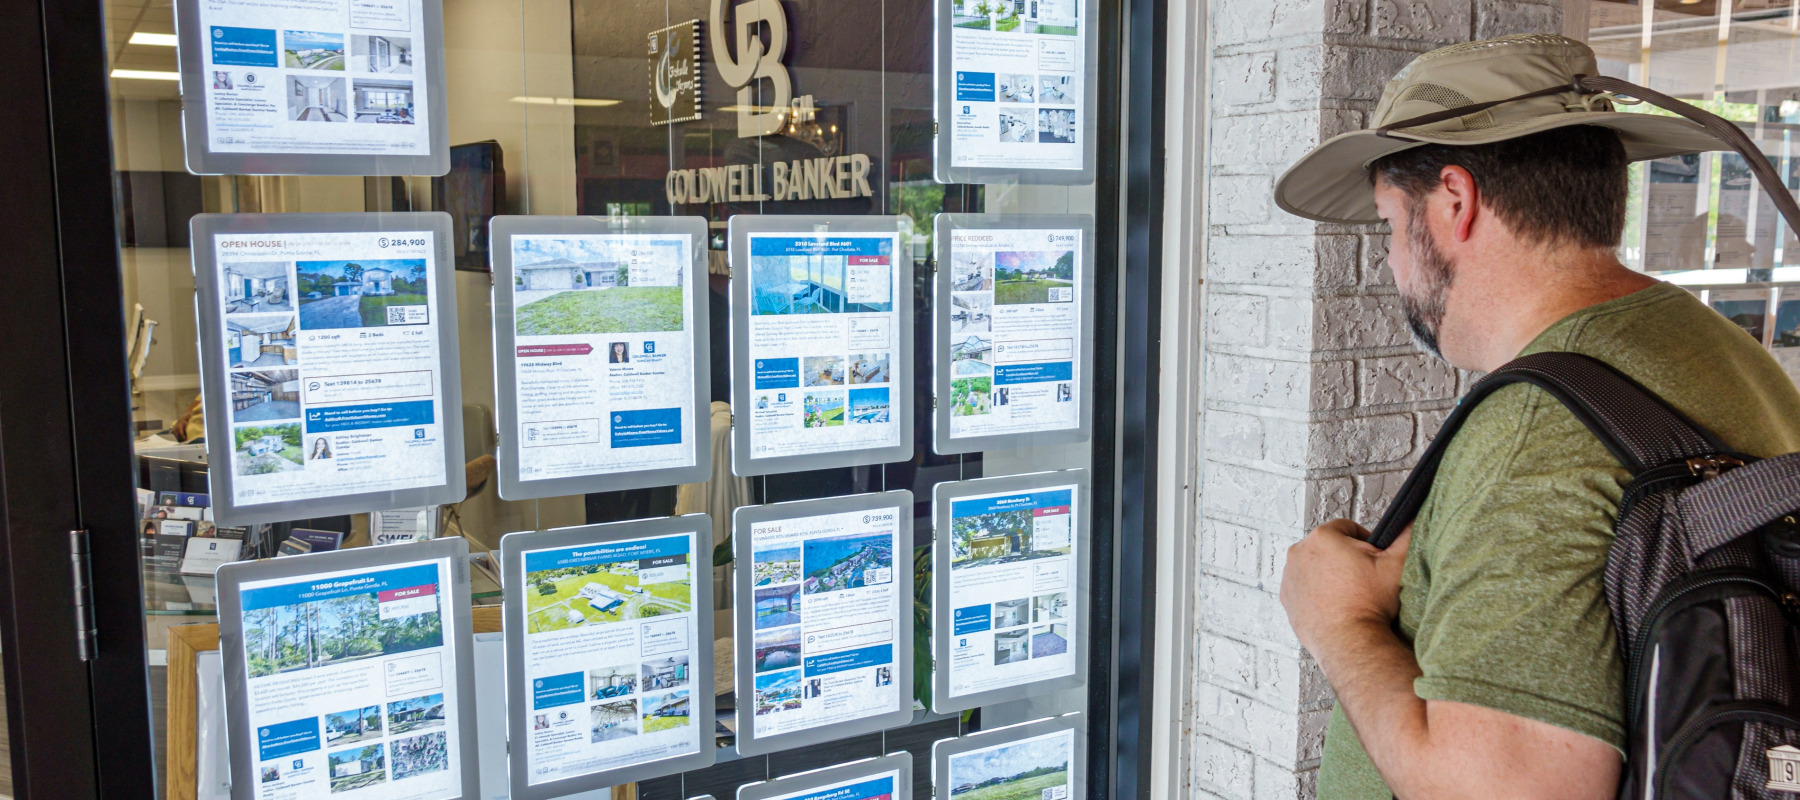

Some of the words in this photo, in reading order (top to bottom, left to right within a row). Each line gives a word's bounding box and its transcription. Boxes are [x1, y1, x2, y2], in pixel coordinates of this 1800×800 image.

[665, 163, 770, 205] COLDWELL
[773, 153, 873, 202] BANKER
[391, 239, 426, 247] 284,900
[767, 525, 782, 533] SALE
[583, 548, 615, 557] possibilities
[311, 581, 333, 590] 11000
[333, 578, 365, 587] Grapefruit
[315, 588, 341, 596] Grapefruit
[1785, 761, 1794, 782] 9
